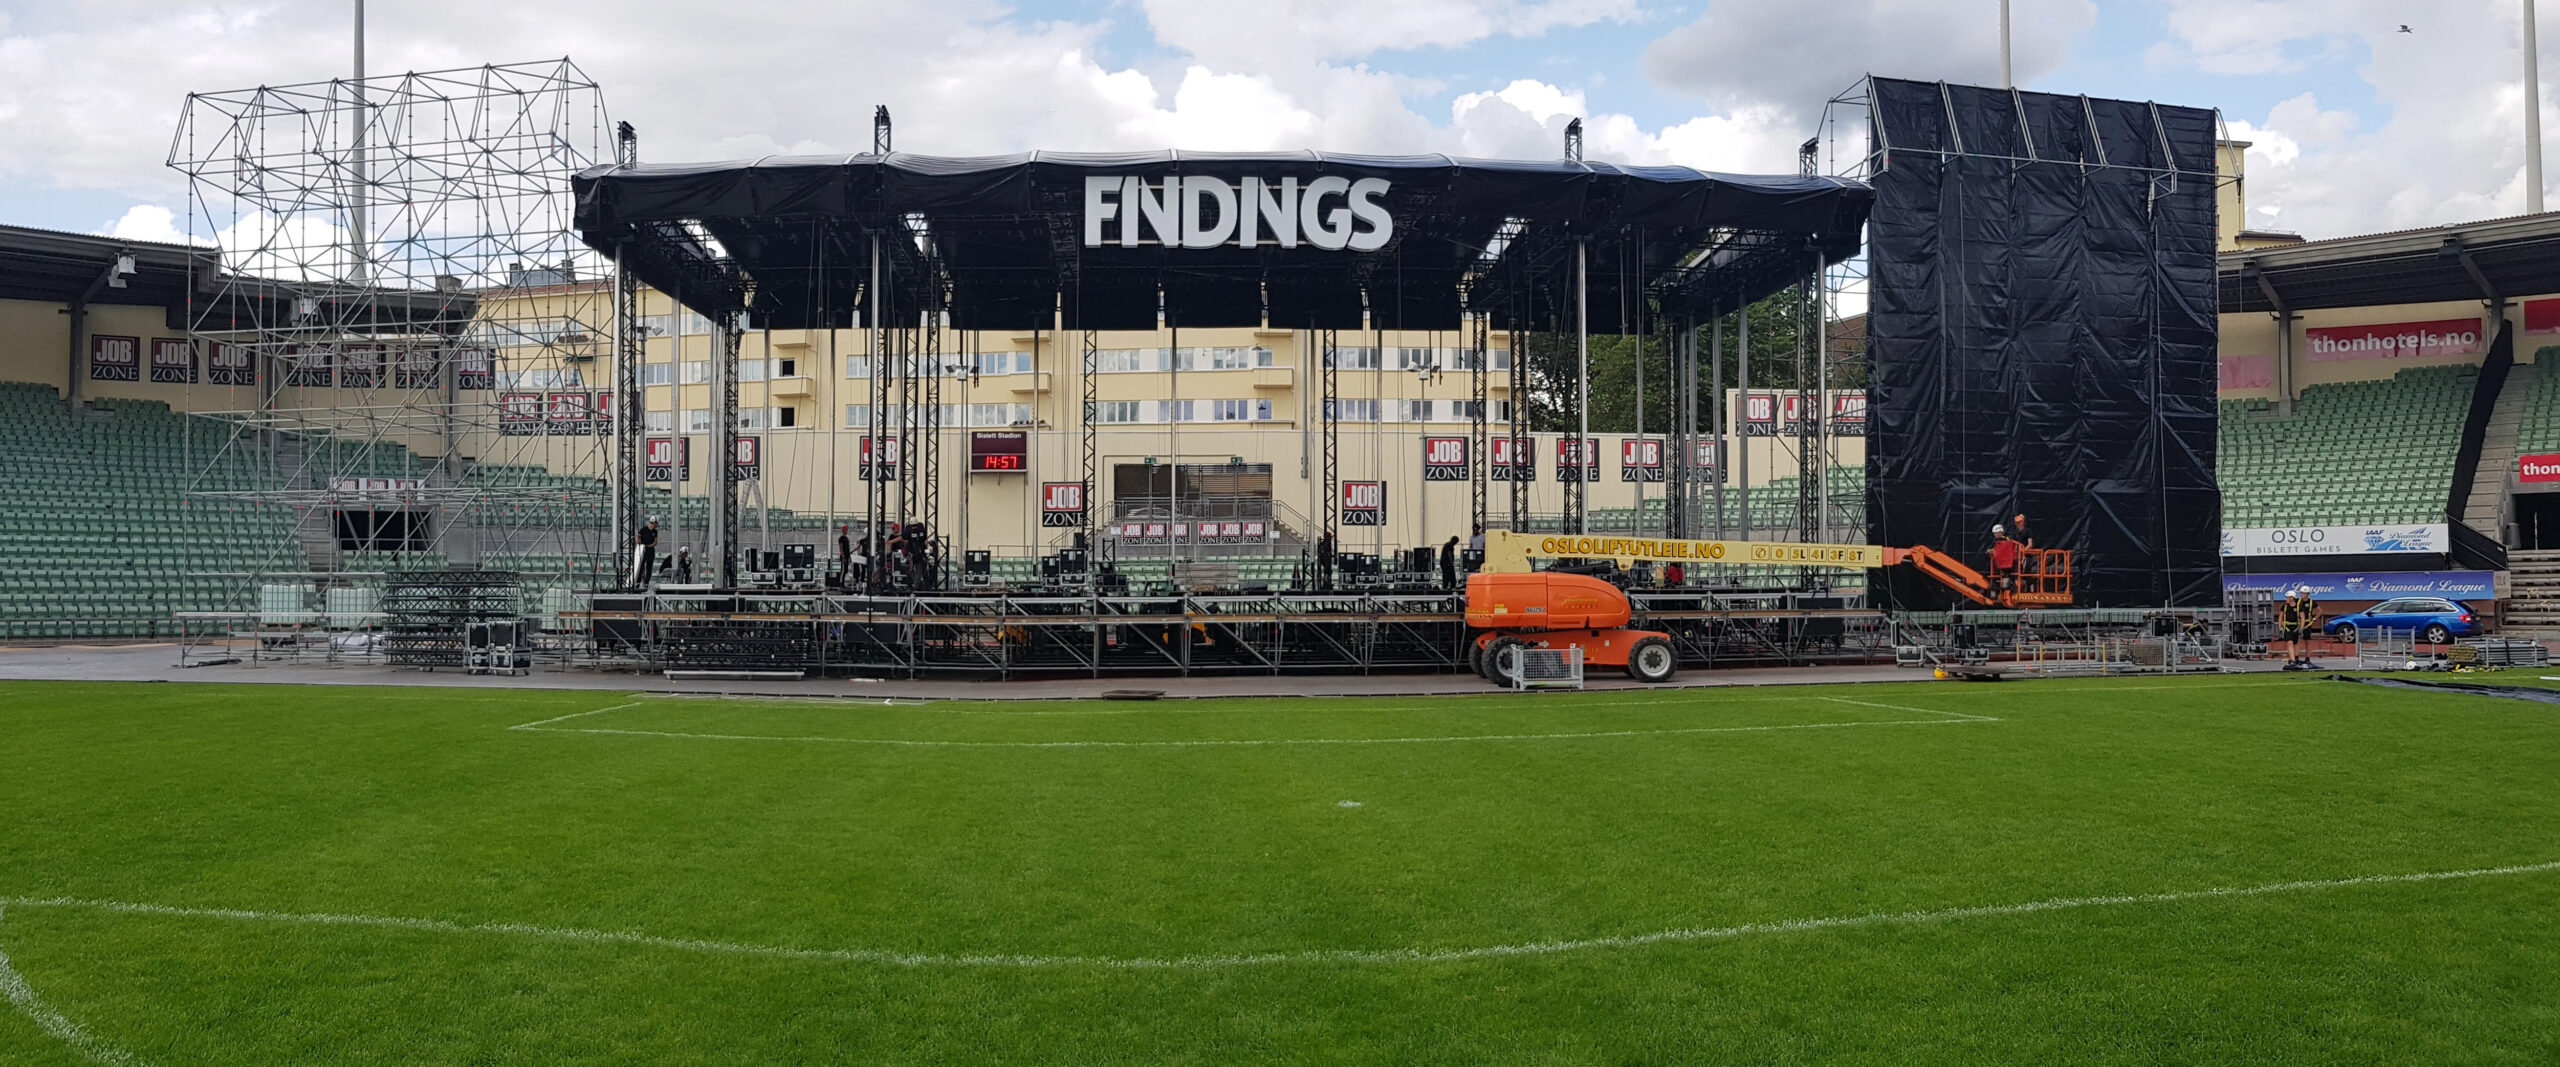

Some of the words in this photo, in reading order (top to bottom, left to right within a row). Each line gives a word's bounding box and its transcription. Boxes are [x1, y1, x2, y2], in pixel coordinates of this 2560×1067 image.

[2313, 329, 2476, 353] thonhotels.no
[96, 339, 132, 363] JOB
[156, 342, 191, 365] JOB
[213, 344, 248, 367] JOB
[92, 366, 138, 379] ZONE
[152, 369, 197, 382] ZONE
[210, 370, 254, 384] ZONE
[289, 372, 331, 386] ZONE
[343, 374, 385, 387] ZONE
[1748, 398, 1770, 419] OB
[1787, 399, 1817, 419] JB
[549, 421, 590, 434] ZONE
[649, 442, 683, 464] JO
[1429, 441, 1461, 463] JOB
[985, 456, 1017, 469] 14:57
[2523, 462, 2560, 476] thon
[648, 467, 688, 480] ZOE
[860, 466, 898, 479] ZN
[1426, 466, 1468, 479] ZONE
[1558, 467, 1599, 480] ZOE
[1046, 486, 1080, 509] JOB
[1346, 485, 1379, 507] JOB
[1044, 512, 1084, 525] ZONE
[1343, 511, 1385, 524] ZONE
[1124, 524, 1140, 536] JOB
[1147, 524, 1164, 536] JOB
[1200, 524, 1217, 535] JOB
[1223, 524, 1240, 535] JOB
[1246, 523, 1262, 535] JOB
[2390, 531, 2432, 540] Diamond
[2272, 529, 2325, 543] OSLO
[1542, 537, 1726, 559] OSLOLIFTUTLEIE.NO
[2304, 545, 2341, 553] GAMES
[2401, 539, 2433, 547] League
[2227, 581, 2287, 593] Diamond
[2291, 581, 2335, 595] Lague
[2368, 581, 2434, 592] Diamond
[2437, 579, 2486, 594] League
